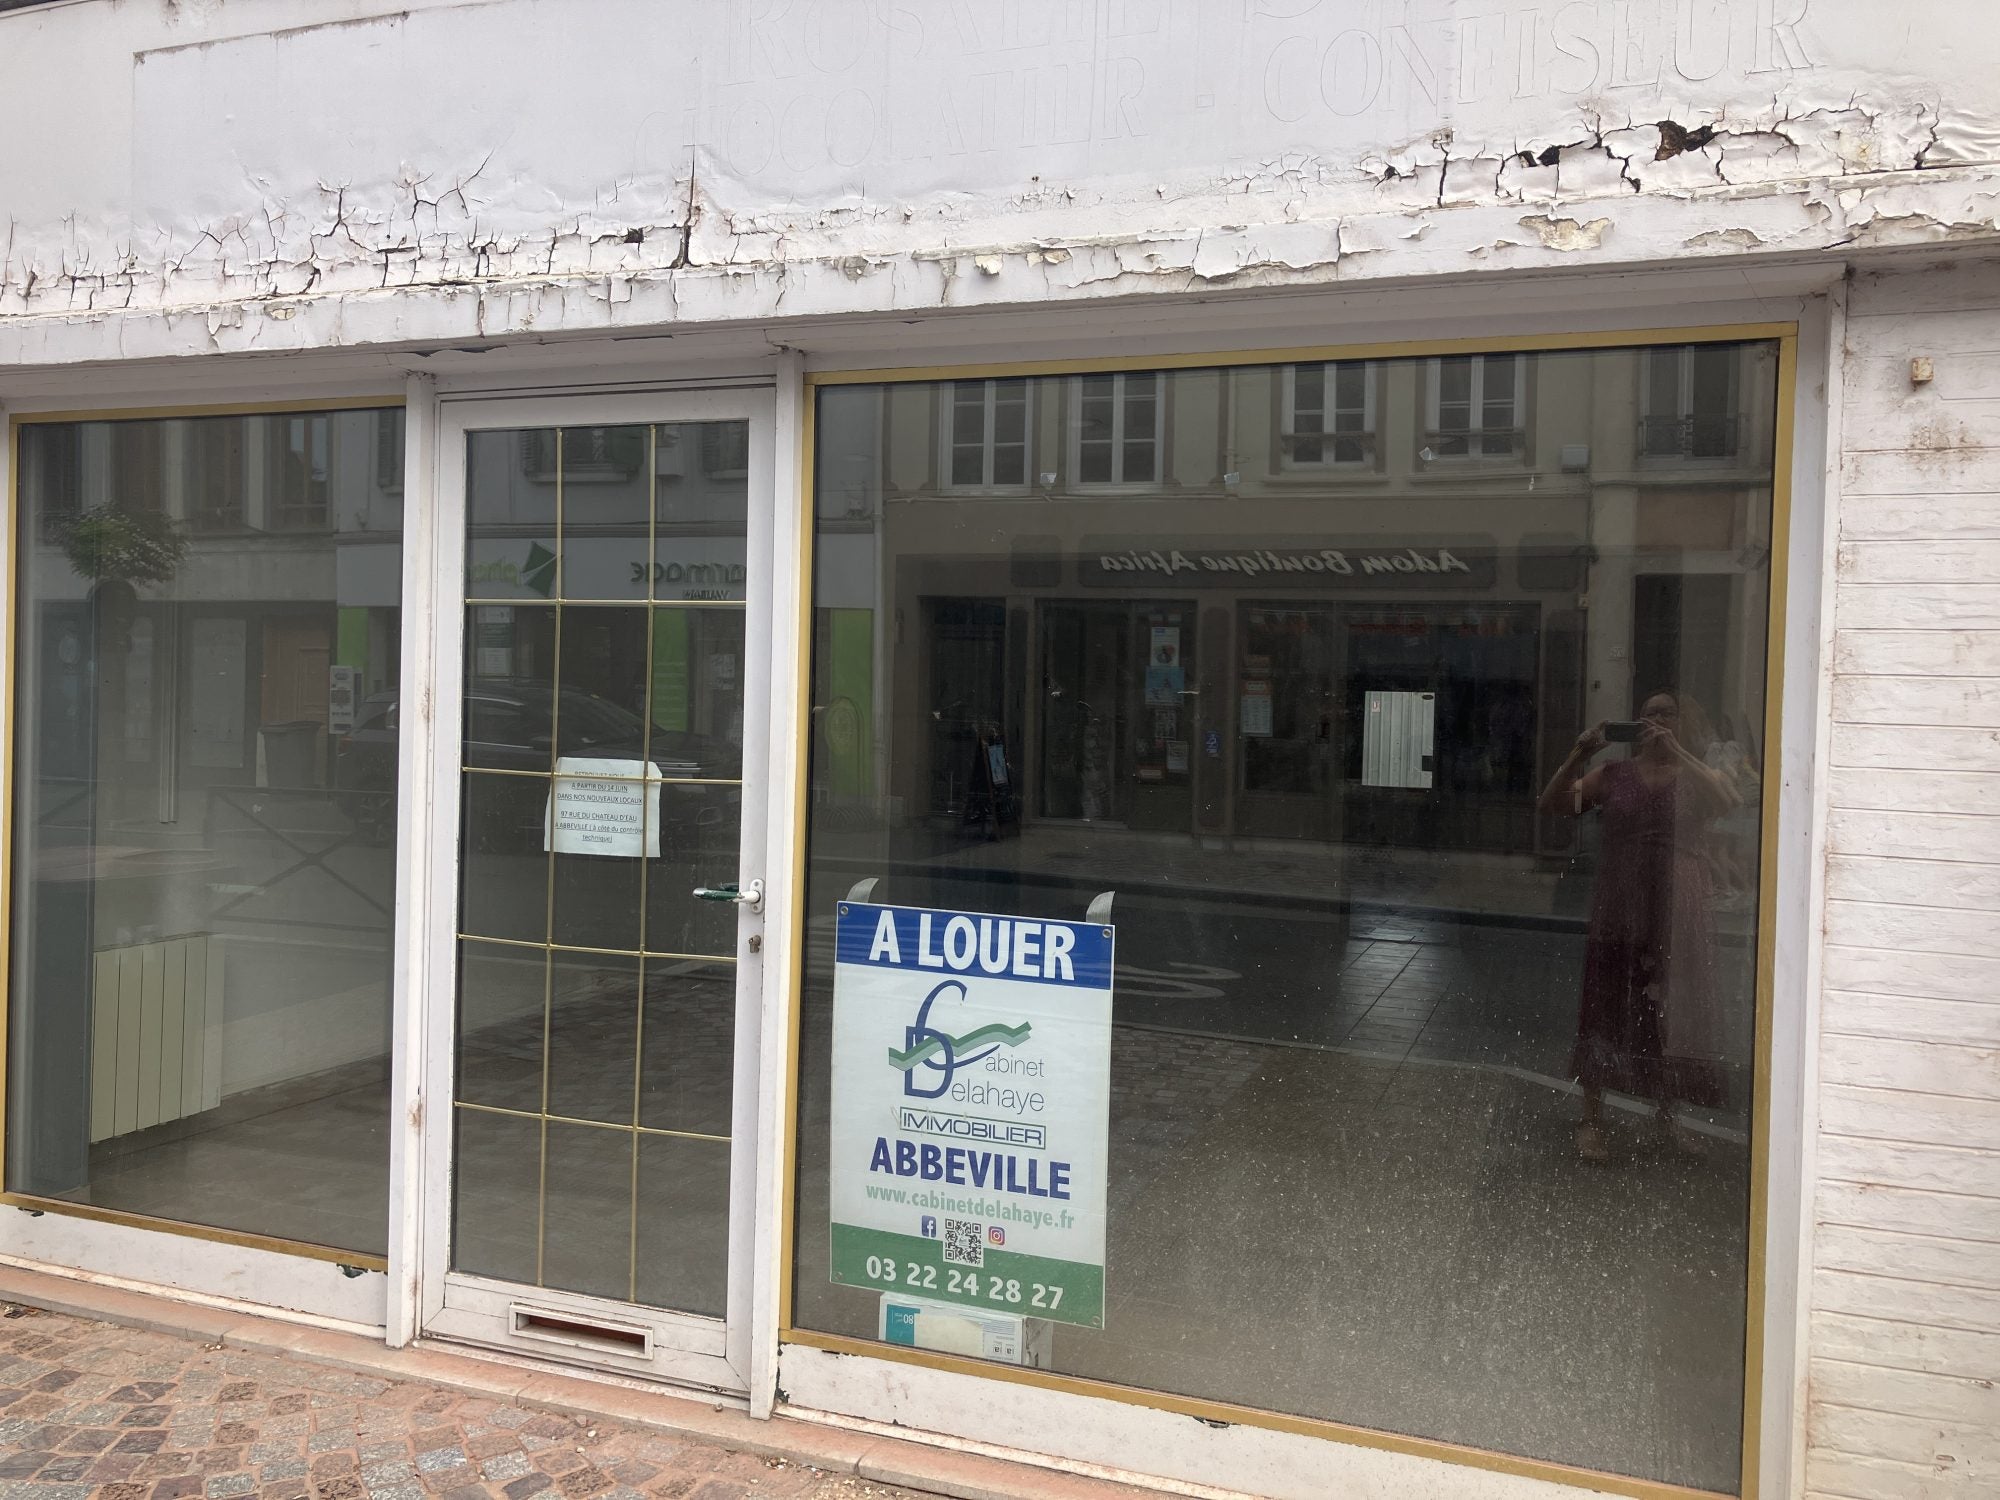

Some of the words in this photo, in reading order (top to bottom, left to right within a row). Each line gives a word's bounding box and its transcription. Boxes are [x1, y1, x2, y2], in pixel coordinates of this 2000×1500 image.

[1263, 0, 1826, 122] CONFISEUR
[576, 782, 597, 790] PARTIR
[597, 783, 606, 791] DU
[587, 795, 619, 803] NOUVEAUX
[619, 796, 643, 804] LOCAUX
[559, 822, 589, 830] ABBEVILLE
[568, 811, 581, 819] RUE
[591, 813, 619, 821] CHATEAU
[868, 910, 901, 964] A
[918, 913, 1076, 981] LOUER
[903, 1112, 1042, 1146] IMMOBILIER
[870, 1137, 1070, 1200] ABBEVILLE
[866, 1184, 1075, 1229] www.cabinetdelahaye.fr
[866, 1255, 897, 1282] 03
[906, 1262, 938, 1290] 22
[947, 1269, 980, 1296] 24
[989, 1276, 1022, 1303] 28
[1031, 1283, 1064, 1310] 27
